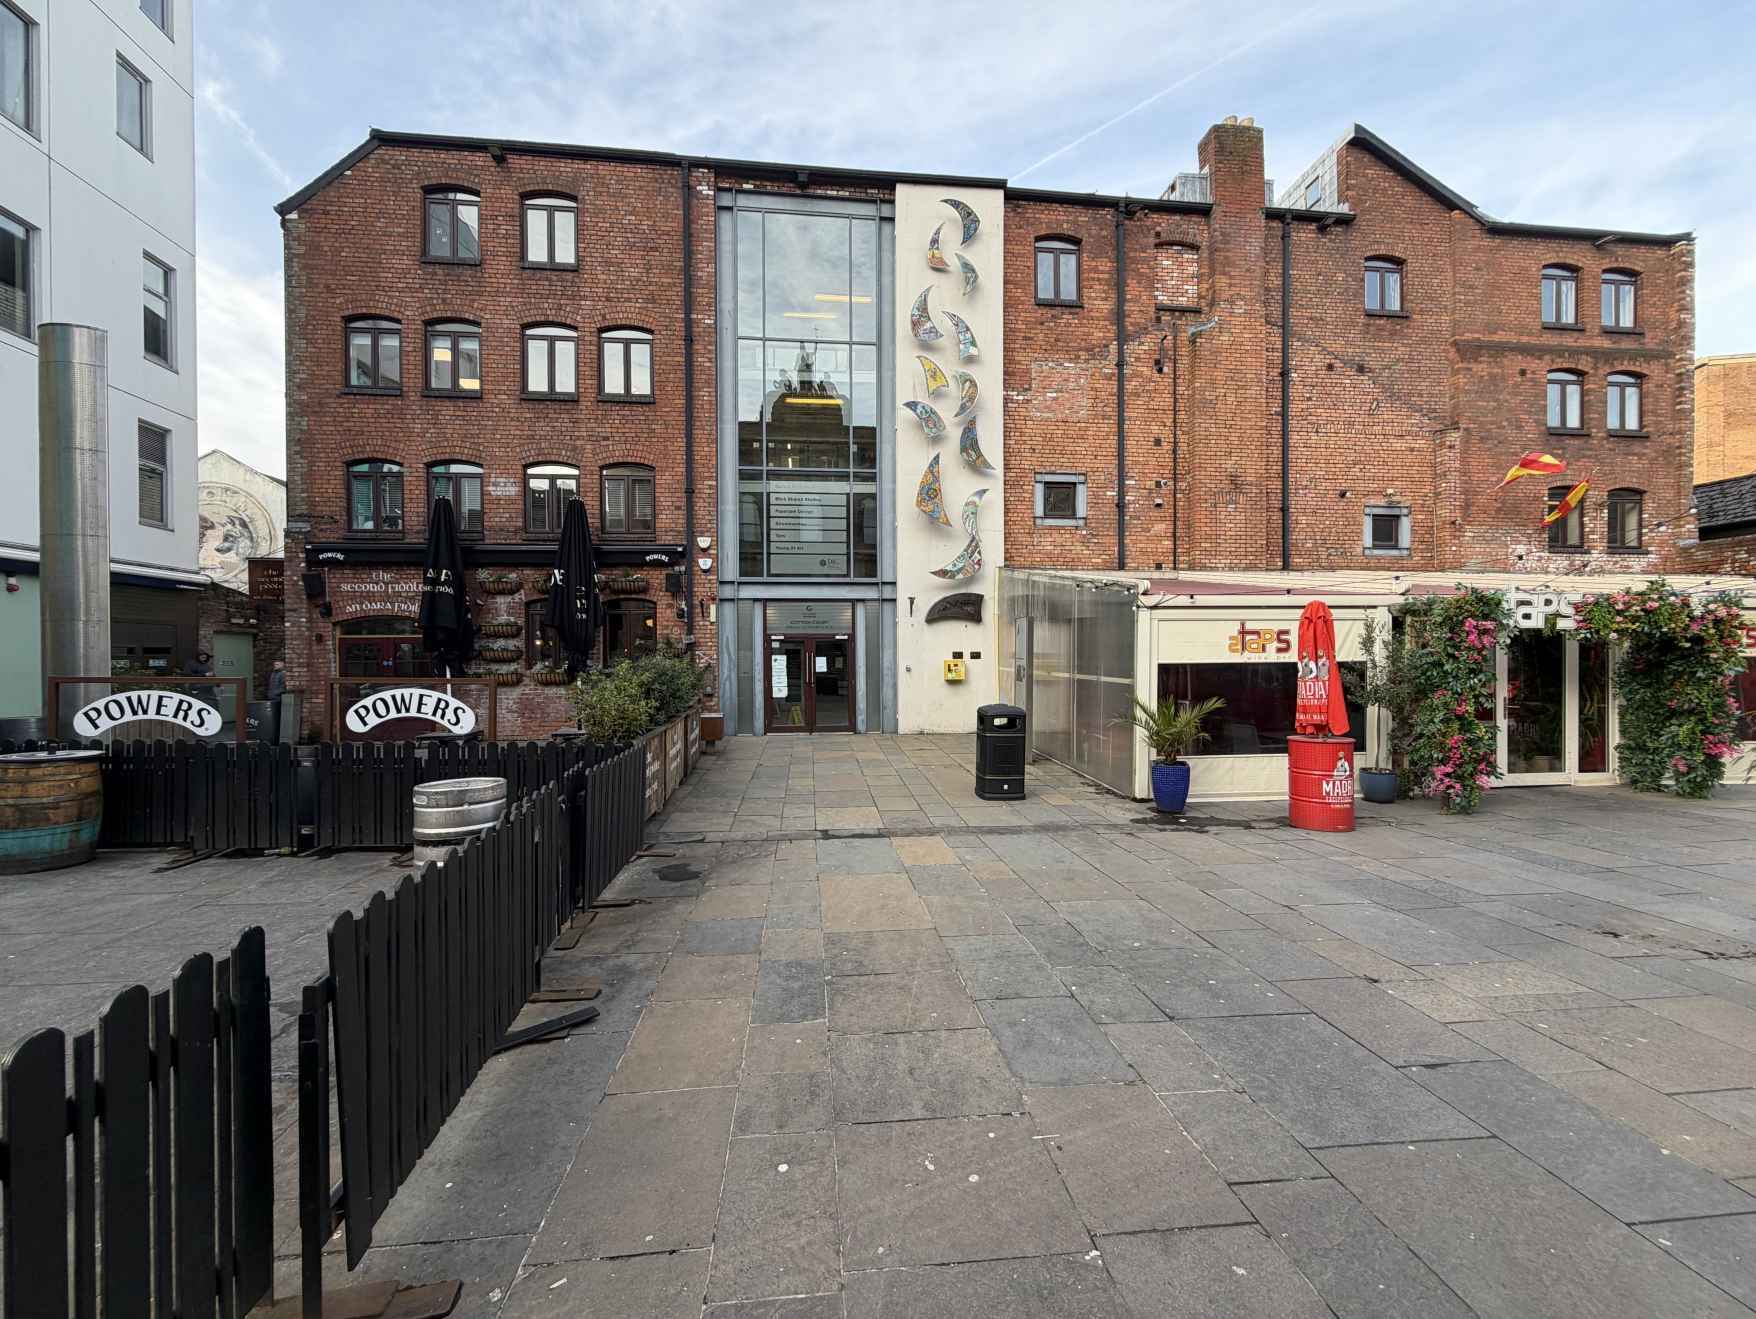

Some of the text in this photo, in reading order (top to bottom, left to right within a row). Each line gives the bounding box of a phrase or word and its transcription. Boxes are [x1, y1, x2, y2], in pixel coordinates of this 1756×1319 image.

[318, 551, 345, 561] POWERS
[645, 553, 670, 563] POWERS
[82, 693, 212, 731] POWERS
[353, 692, 466, 727] POWERS
